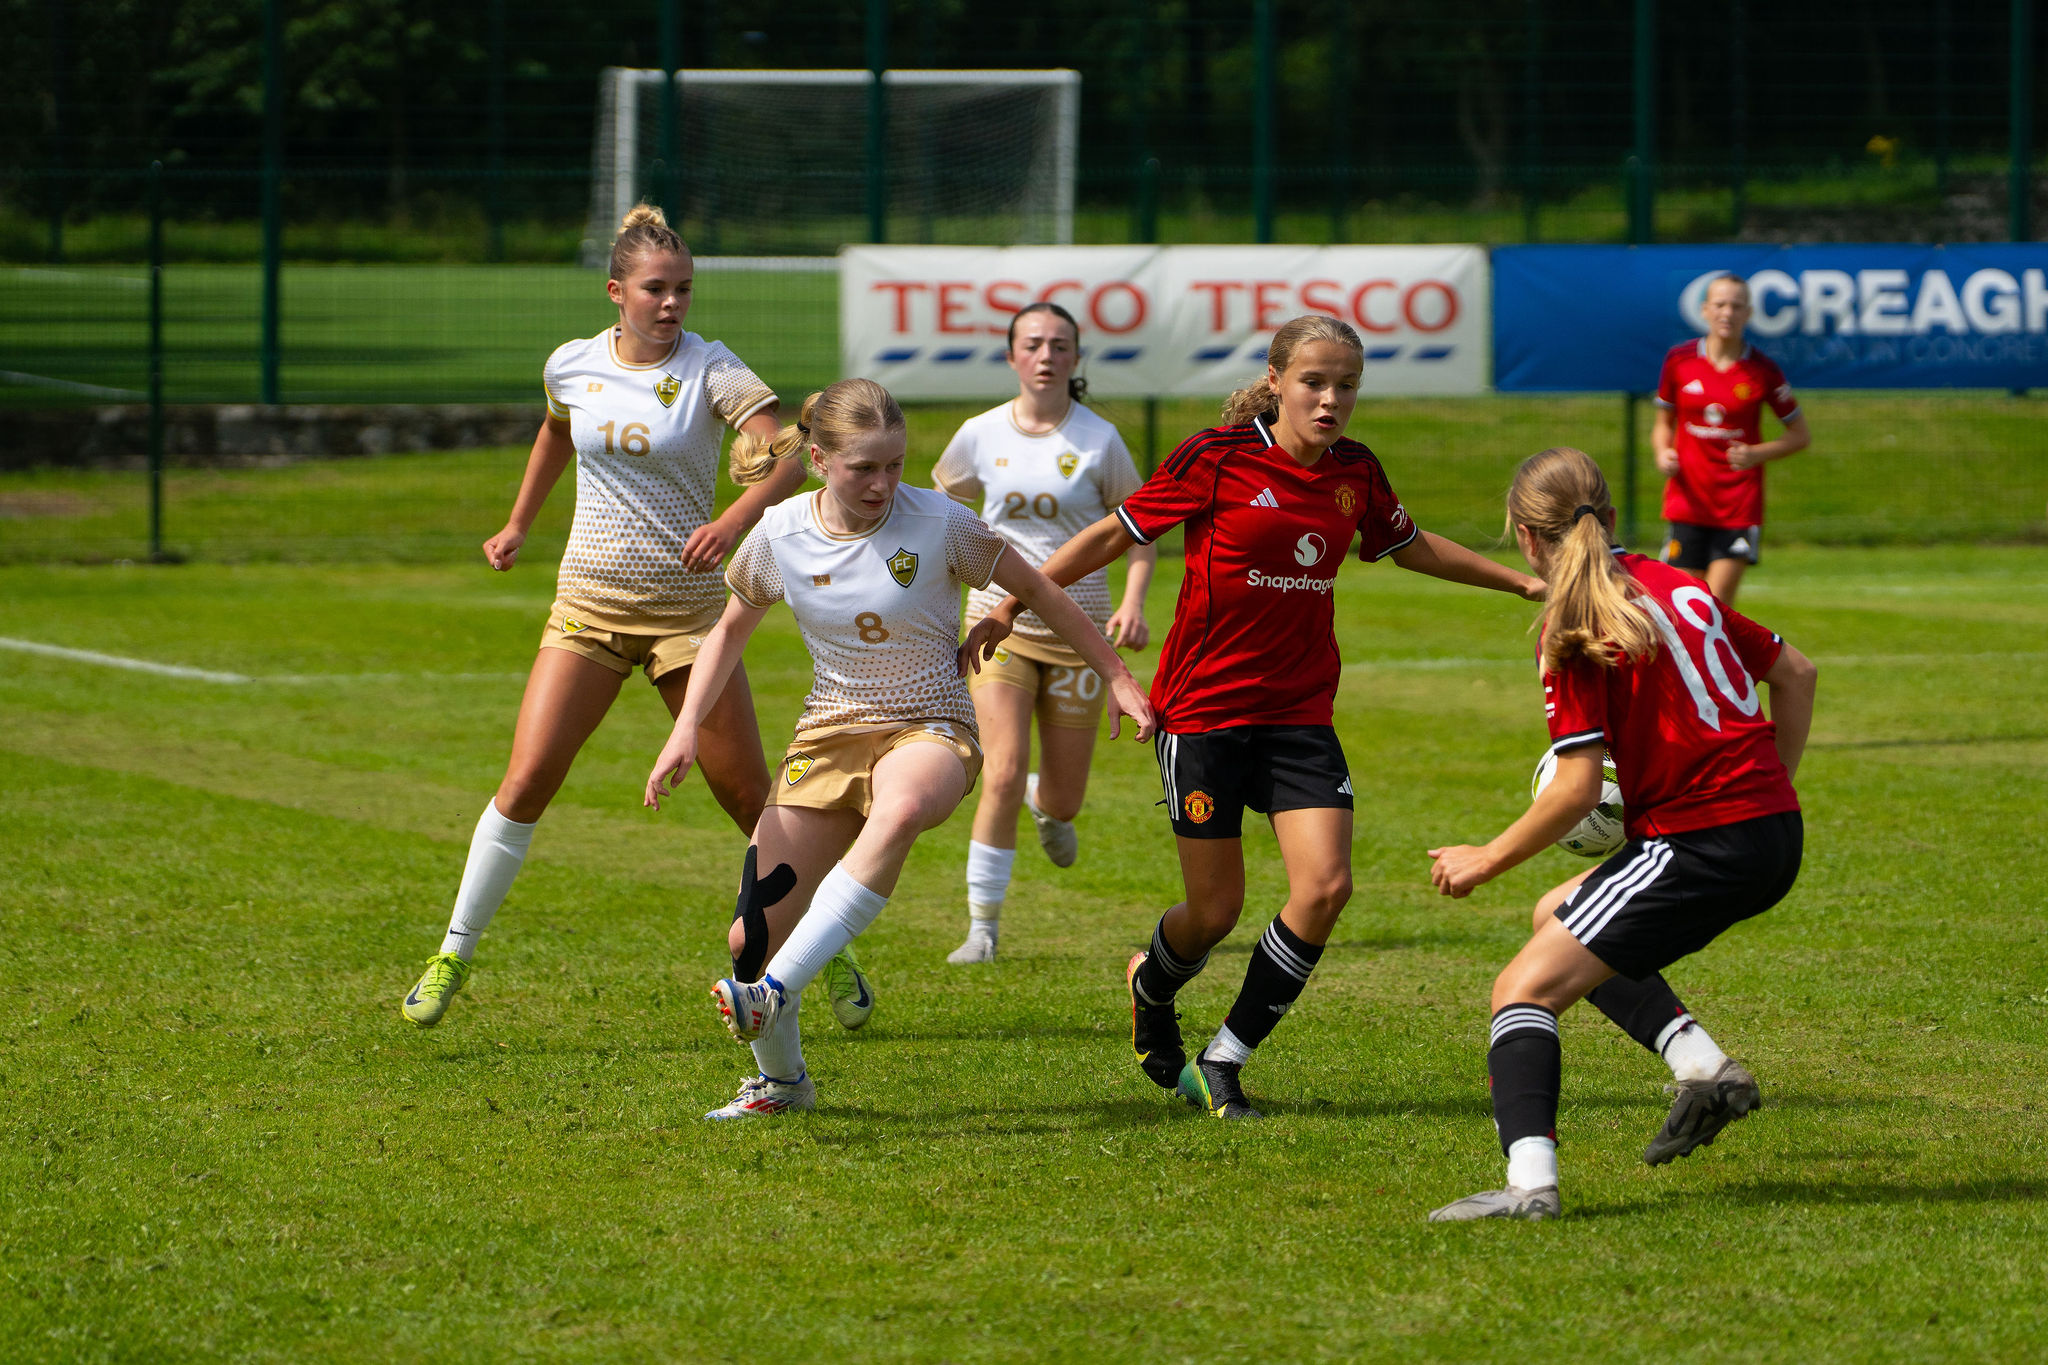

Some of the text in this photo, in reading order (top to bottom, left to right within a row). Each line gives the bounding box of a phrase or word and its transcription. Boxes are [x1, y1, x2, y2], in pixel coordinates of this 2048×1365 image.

[1190, 280, 1459, 335] TESCO
[660, 381, 675, 393] FC
[597, 420, 650, 457] 16
[1004, 491, 1058, 520] 20
[894, 557, 912, 571] FC
[854, 611, 889, 645] 8
[1630, 585, 1759, 732] 18
[1047, 666, 1101, 701] 20
[1586, 811, 1611, 840] hlsport
